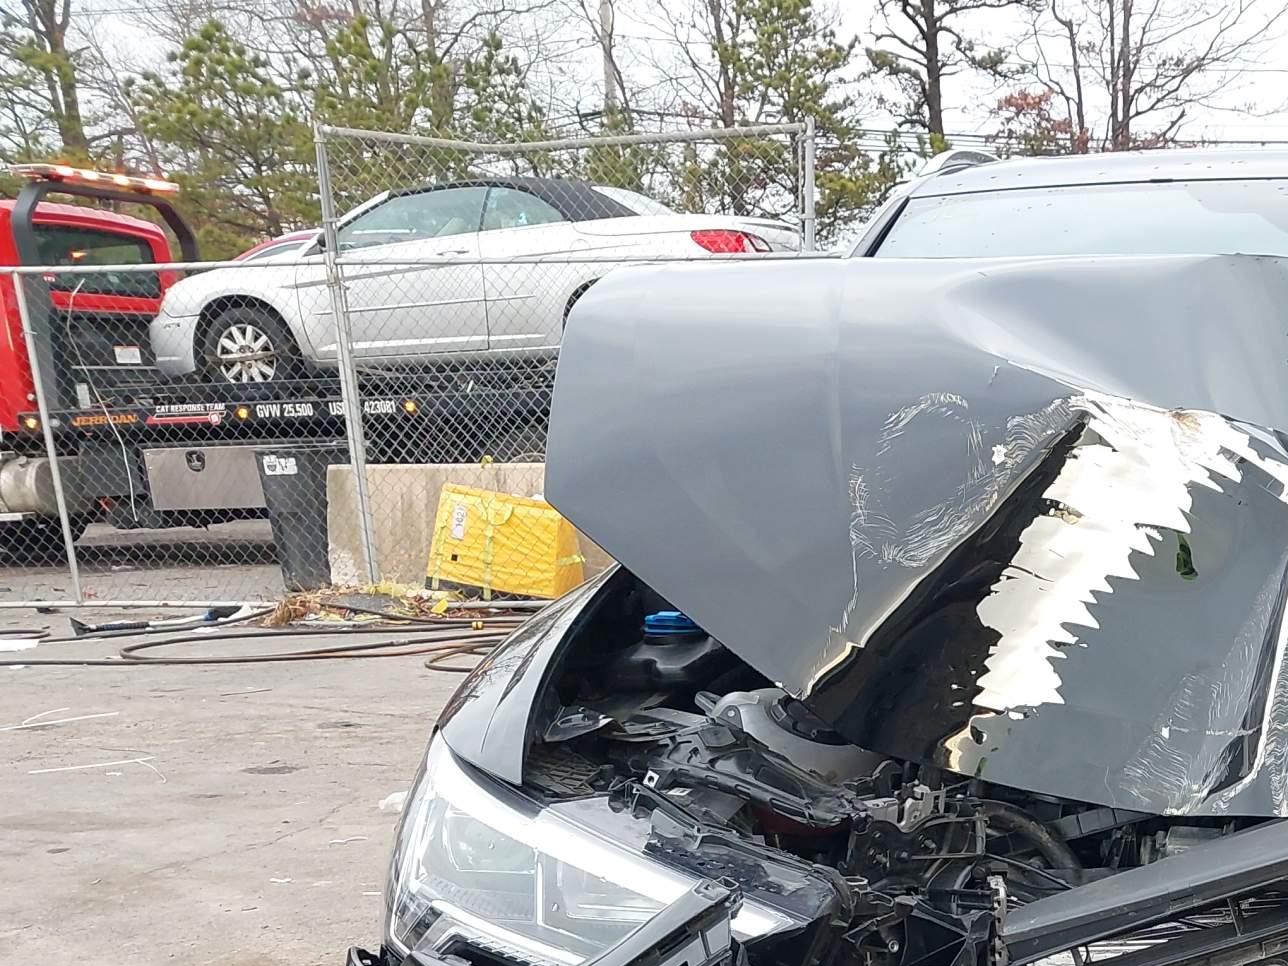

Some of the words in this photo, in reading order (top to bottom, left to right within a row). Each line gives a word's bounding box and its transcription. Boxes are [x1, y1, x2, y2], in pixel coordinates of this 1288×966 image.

[156, 405, 169, 413] CAT
[171, 404, 205, 412] RESPONSE
[206, 402, 225, 411] TEAM
[256, 403, 280, 418] GVW
[283, 403, 314, 418] 25,500
